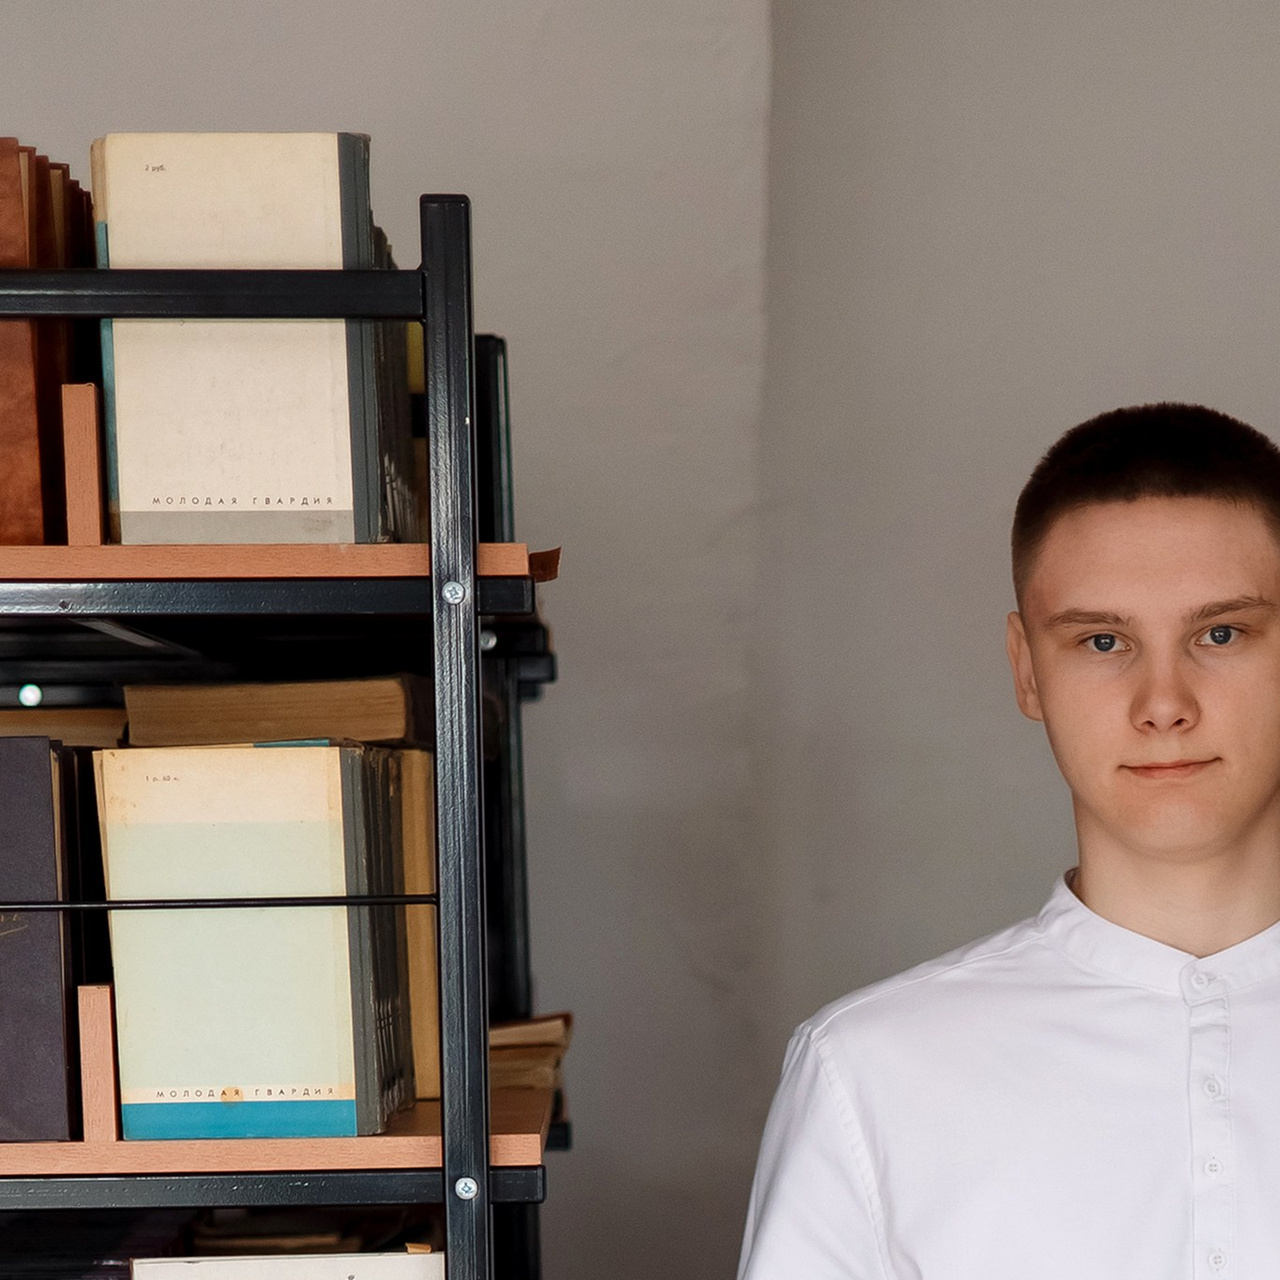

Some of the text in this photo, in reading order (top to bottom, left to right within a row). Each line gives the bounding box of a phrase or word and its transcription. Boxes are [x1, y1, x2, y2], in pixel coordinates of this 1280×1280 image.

[152, 496, 333, 505] МОЛОДАЯ ГВАРДИЯ
[156, 1088, 334, 1098] МОЛОДАЯ ГВАРДИЯ
